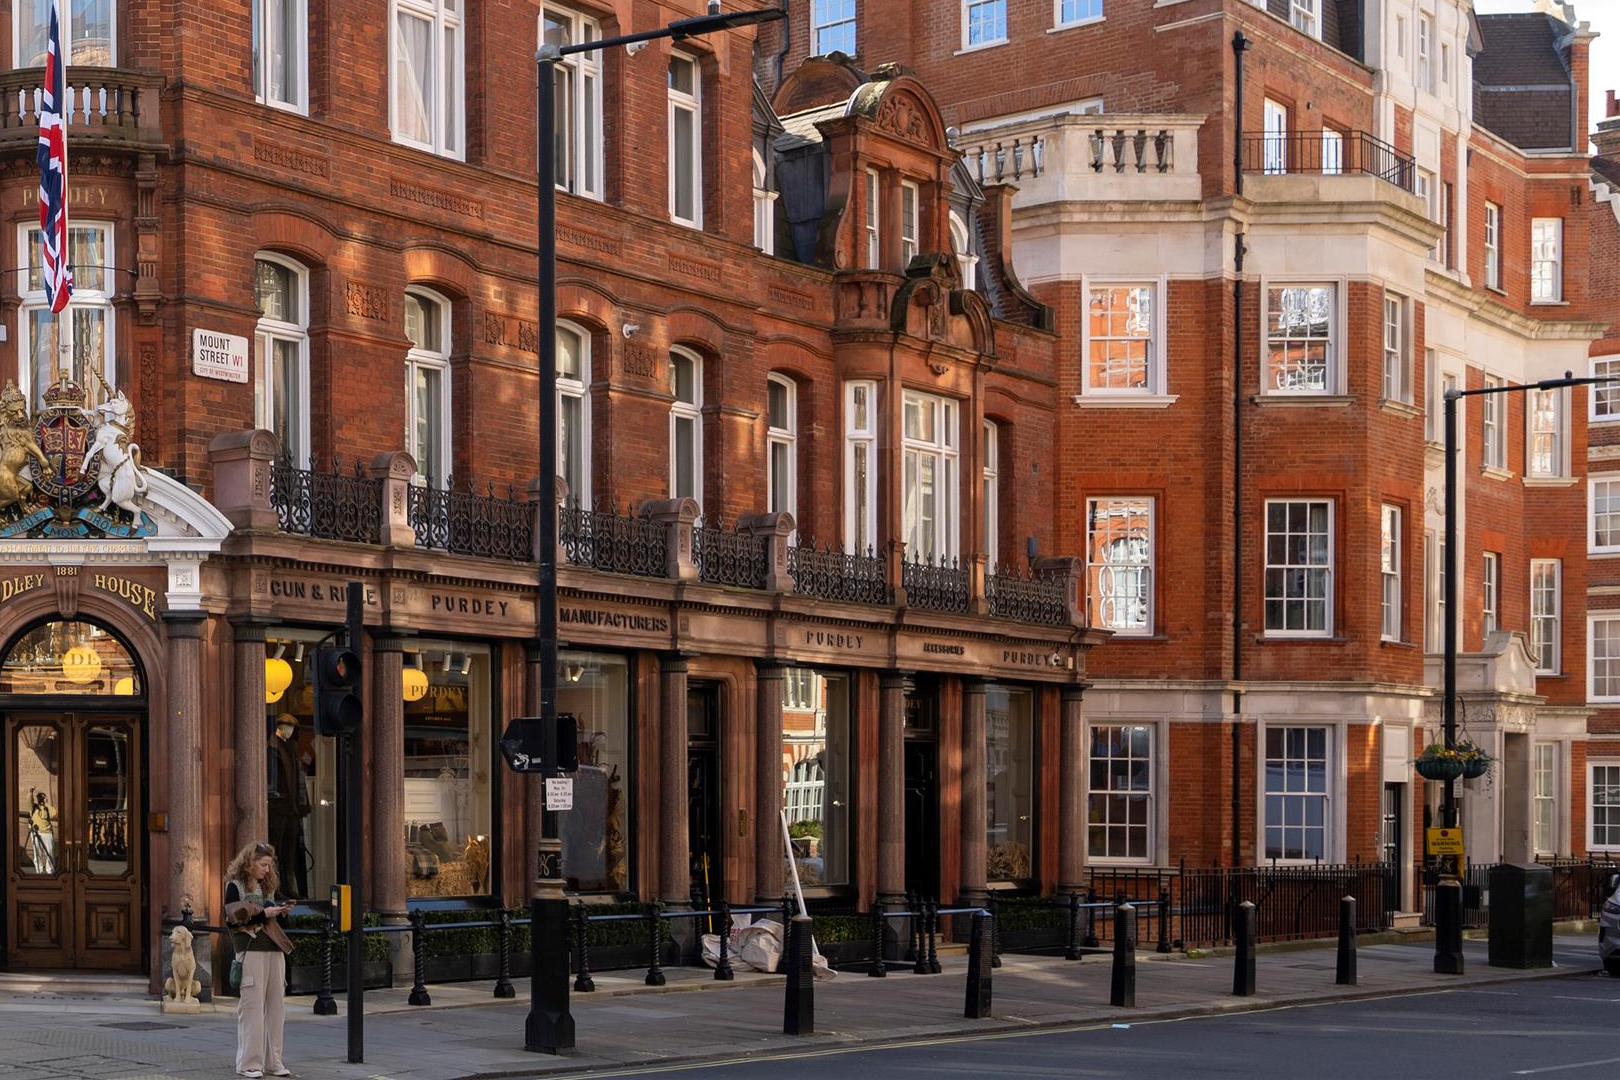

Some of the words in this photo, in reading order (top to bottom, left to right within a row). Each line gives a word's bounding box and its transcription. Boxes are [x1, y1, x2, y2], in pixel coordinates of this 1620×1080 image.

[200, 334, 230, 350] MOUNT
[200, 349, 229, 365] STREET
[232, 354, 243, 367] W1
[50, 526, 80, 537] MON
[57, 567, 77, 576] 1881
[95, 574, 156, 621] HOUSE
[270, 581, 305, 598] GUN
[312, 584, 324, 600] &
[329, 584, 377, 605] RIE
[432, 594, 509, 617] PURDEY
[559, 607, 669, 632] MANUFACTURERS
[806, 631, 864, 649] PURDEY
[923, 642, 965, 656] ACCESSORIES
[1003, 650, 1049, 667] PURDEY
[411, 685, 465, 698] PURDEY
